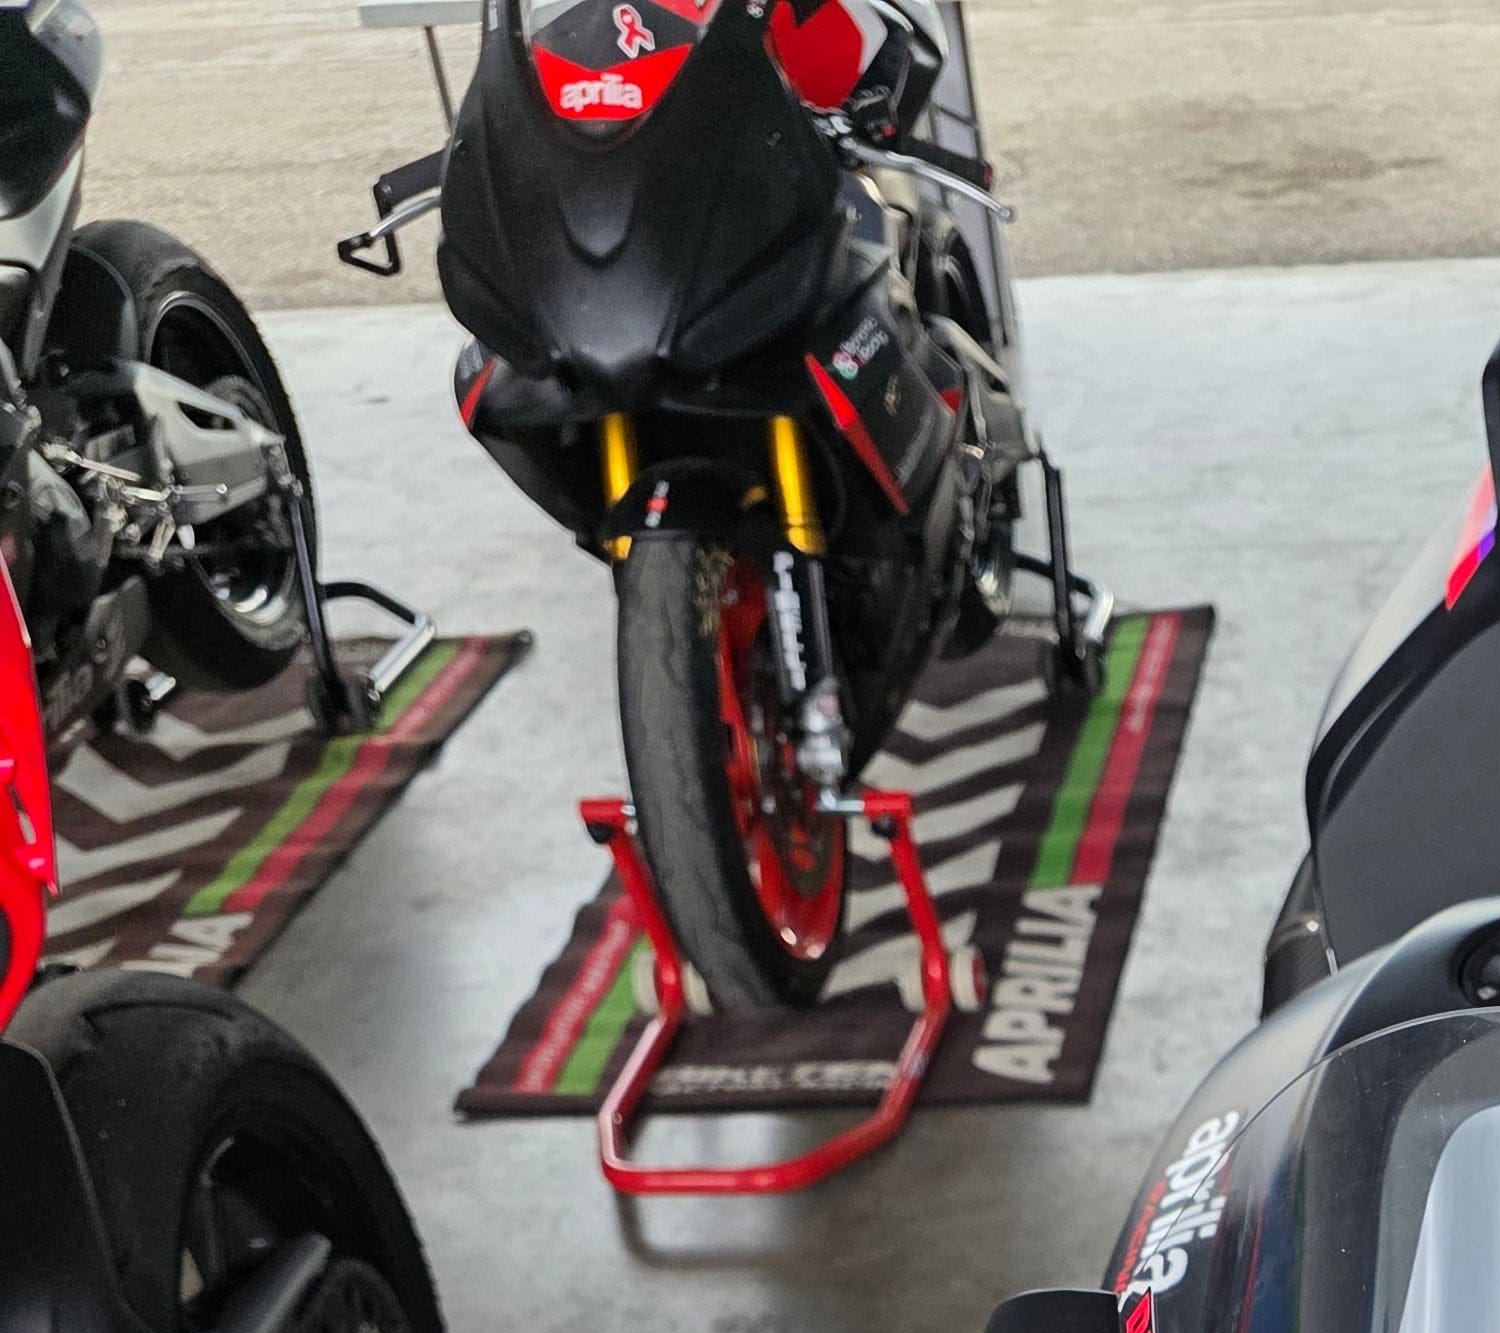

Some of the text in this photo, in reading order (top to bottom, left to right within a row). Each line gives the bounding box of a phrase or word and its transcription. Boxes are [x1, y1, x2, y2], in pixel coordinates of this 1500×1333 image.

[560, 73, 643, 111] aprilia
[971, 884, 1103, 1084] APRILIA
[1118, 1110, 1240, 1313] aprilia
